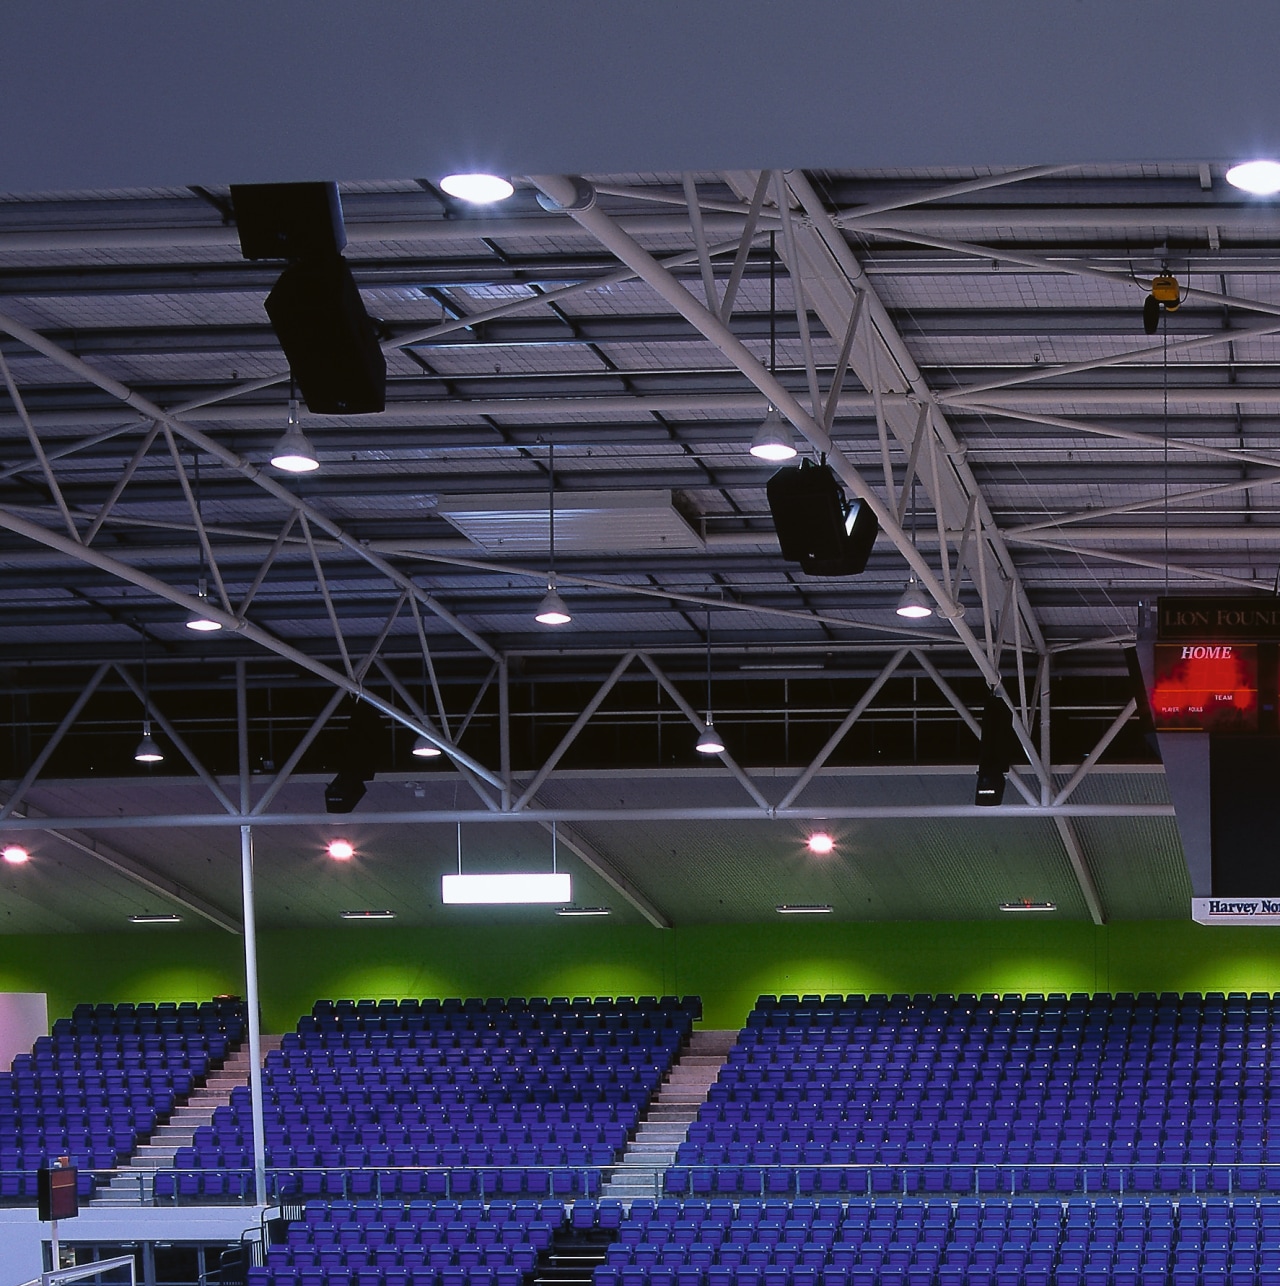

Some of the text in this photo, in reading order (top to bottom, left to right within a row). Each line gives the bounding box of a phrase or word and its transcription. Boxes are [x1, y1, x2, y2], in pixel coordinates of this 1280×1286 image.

[1164, 609, 1210, 627] LION
[1180, 646, 1233, 661] HOME
[1209, 901, 1258, 915] Harvey
